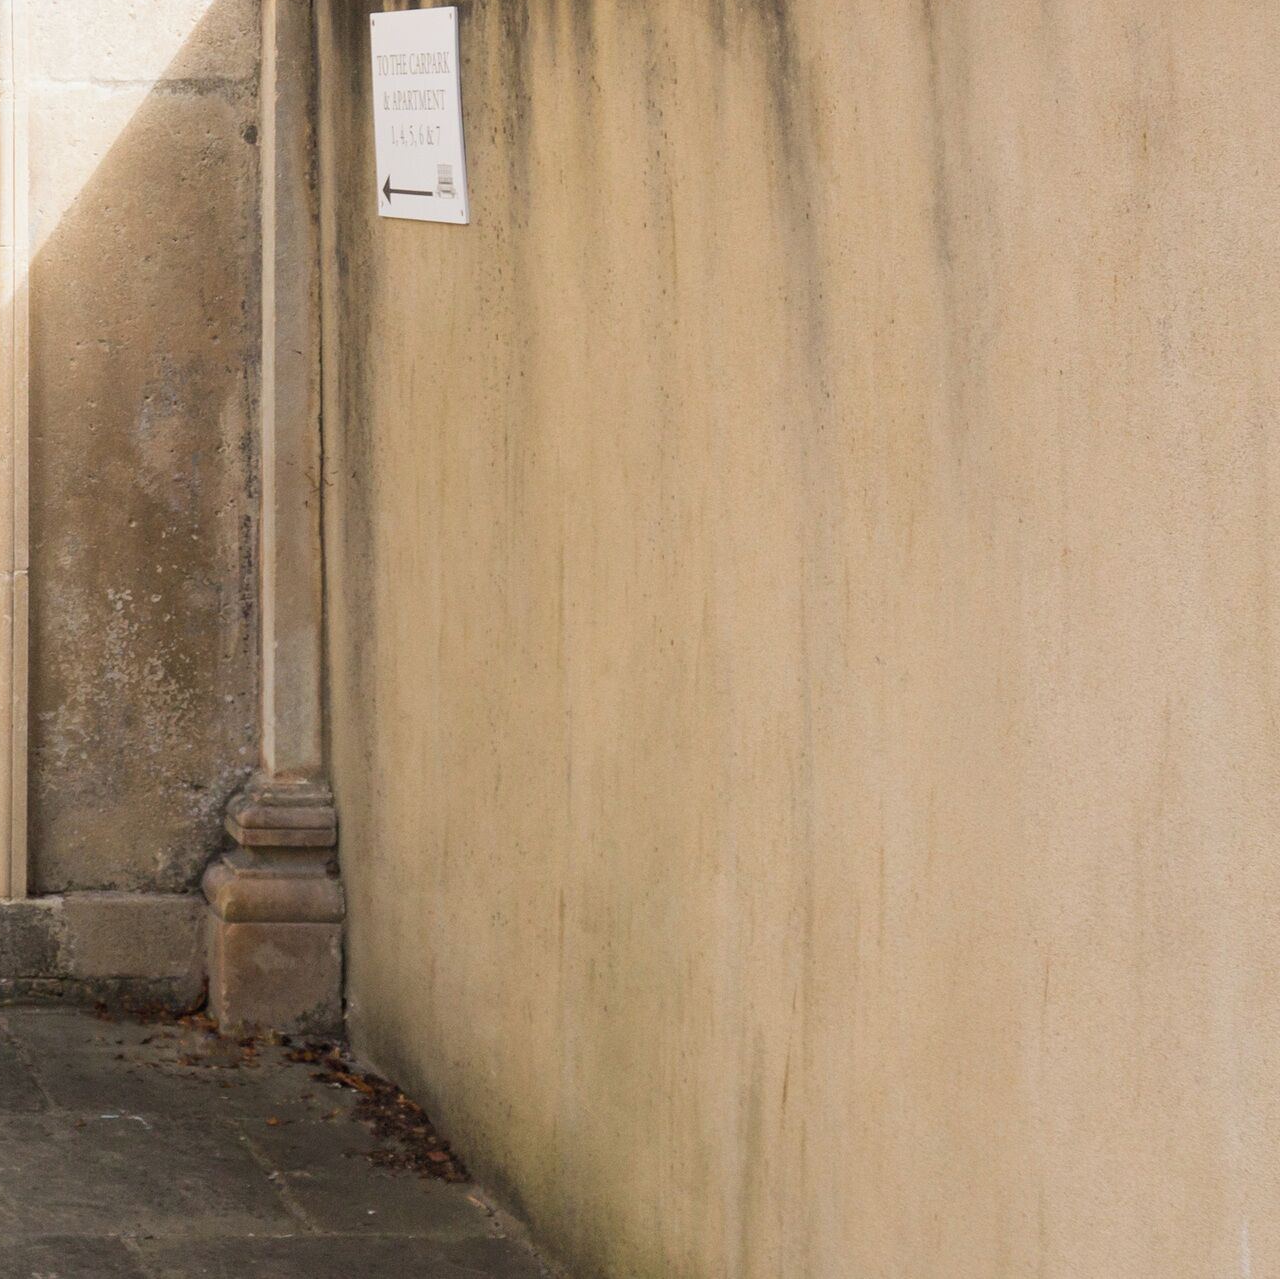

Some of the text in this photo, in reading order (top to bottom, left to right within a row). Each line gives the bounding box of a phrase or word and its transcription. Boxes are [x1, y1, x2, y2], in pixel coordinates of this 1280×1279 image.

[377, 52, 450, 76] TO THE CARPARK
[383, 89, 446, 111] & APARTMENT
[419, 125, 424, 145] 6
[426, 126, 434, 145] &
[436, 126, 440, 145] 7
